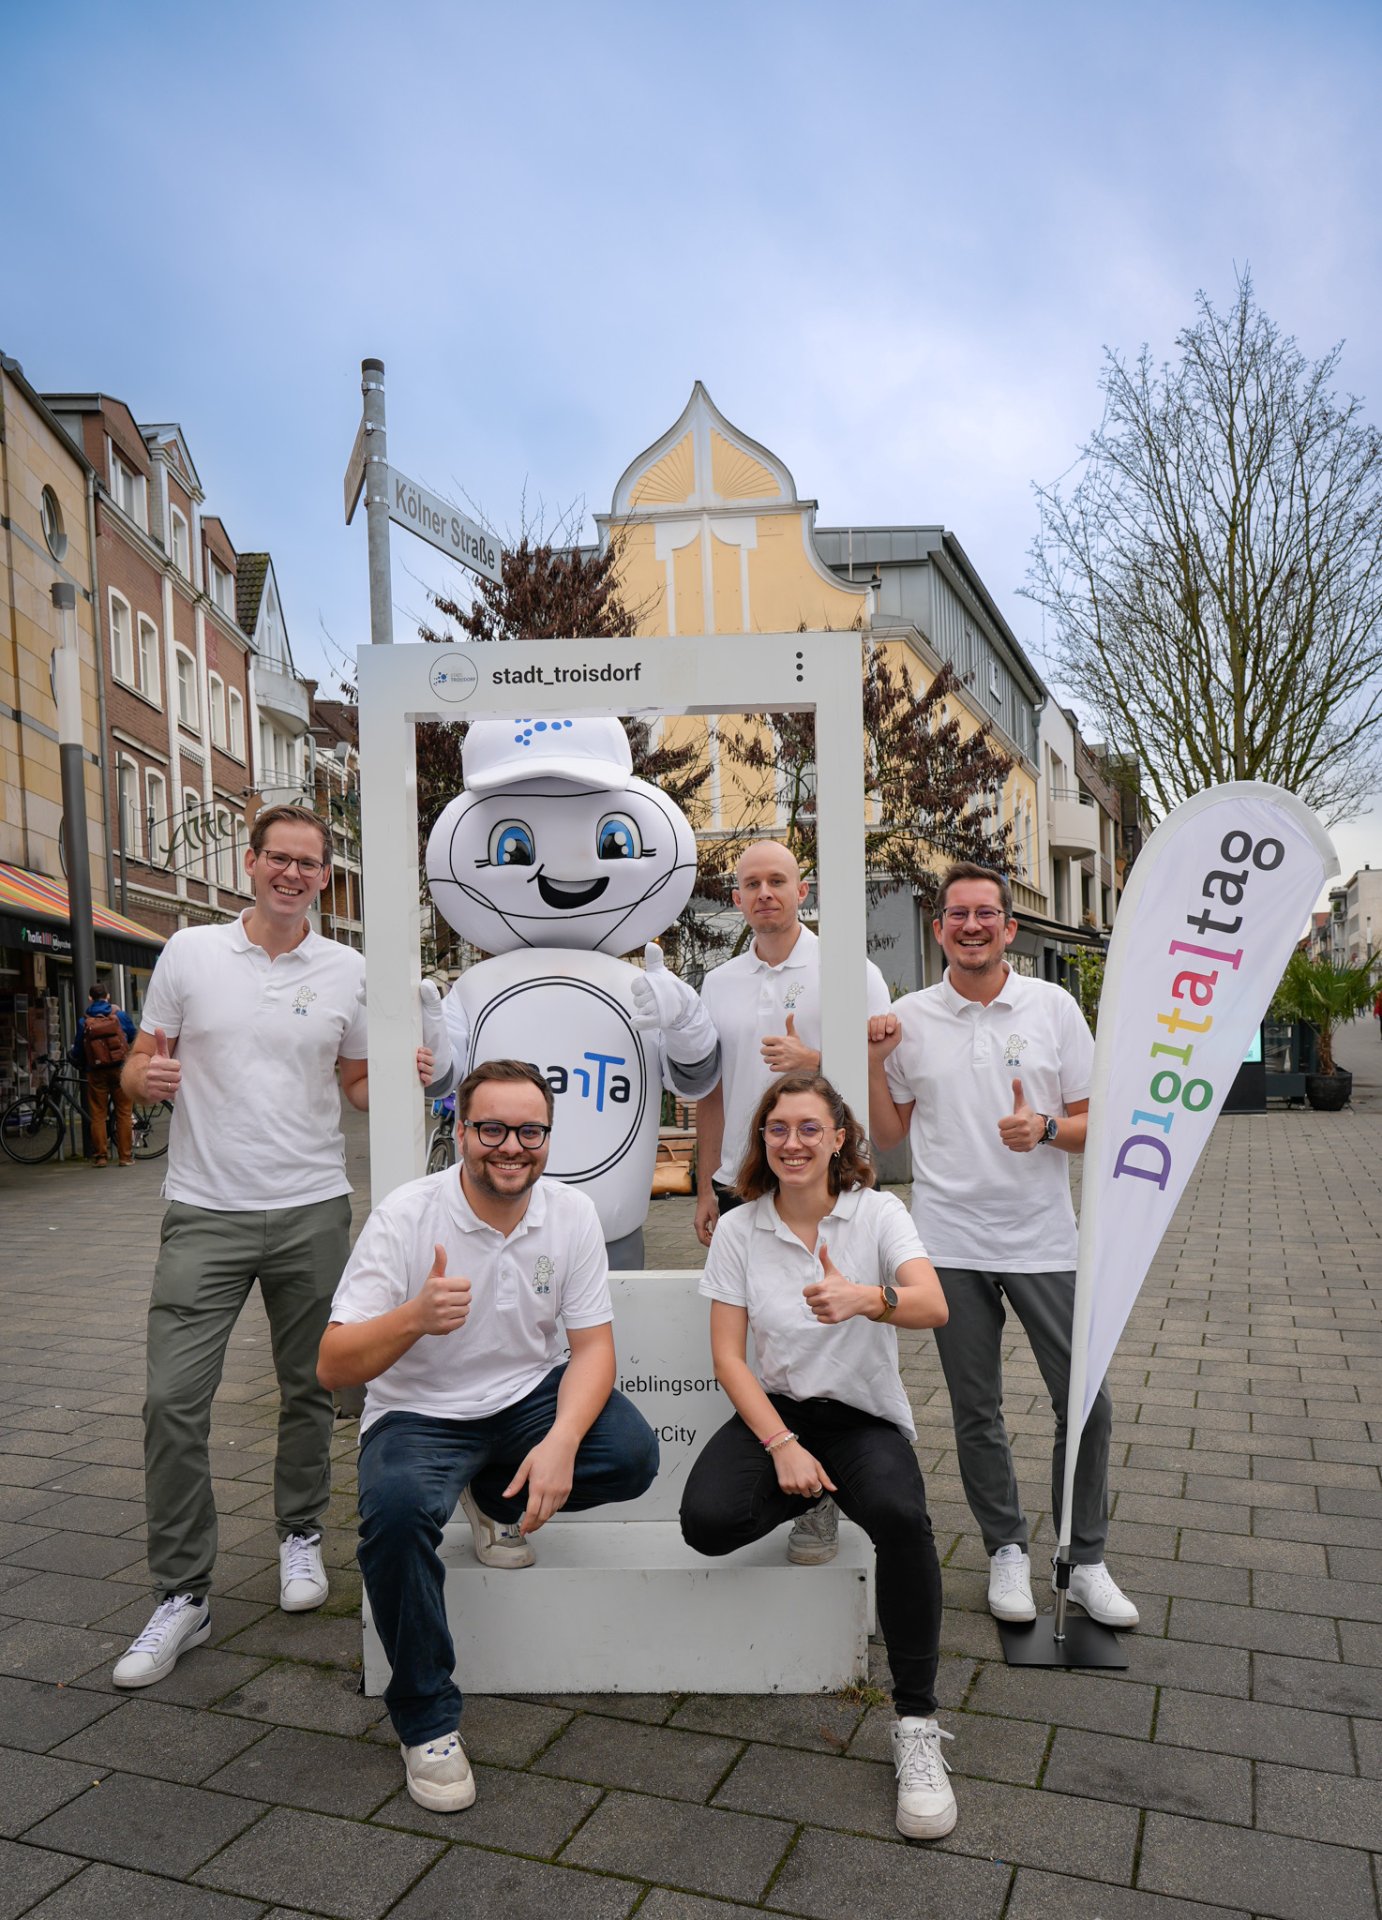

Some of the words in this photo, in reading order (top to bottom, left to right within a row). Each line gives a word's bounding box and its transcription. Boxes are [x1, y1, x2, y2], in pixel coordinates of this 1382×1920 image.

[396, 478, 447, 538] Kölner
[450, 517, 495, 570] Straße
[492, 662, 641, 686] stadt_troisdorf
[620, 1375, 720, 1396] ieblingsort
[653, 1424, 697, 1446] tCity
